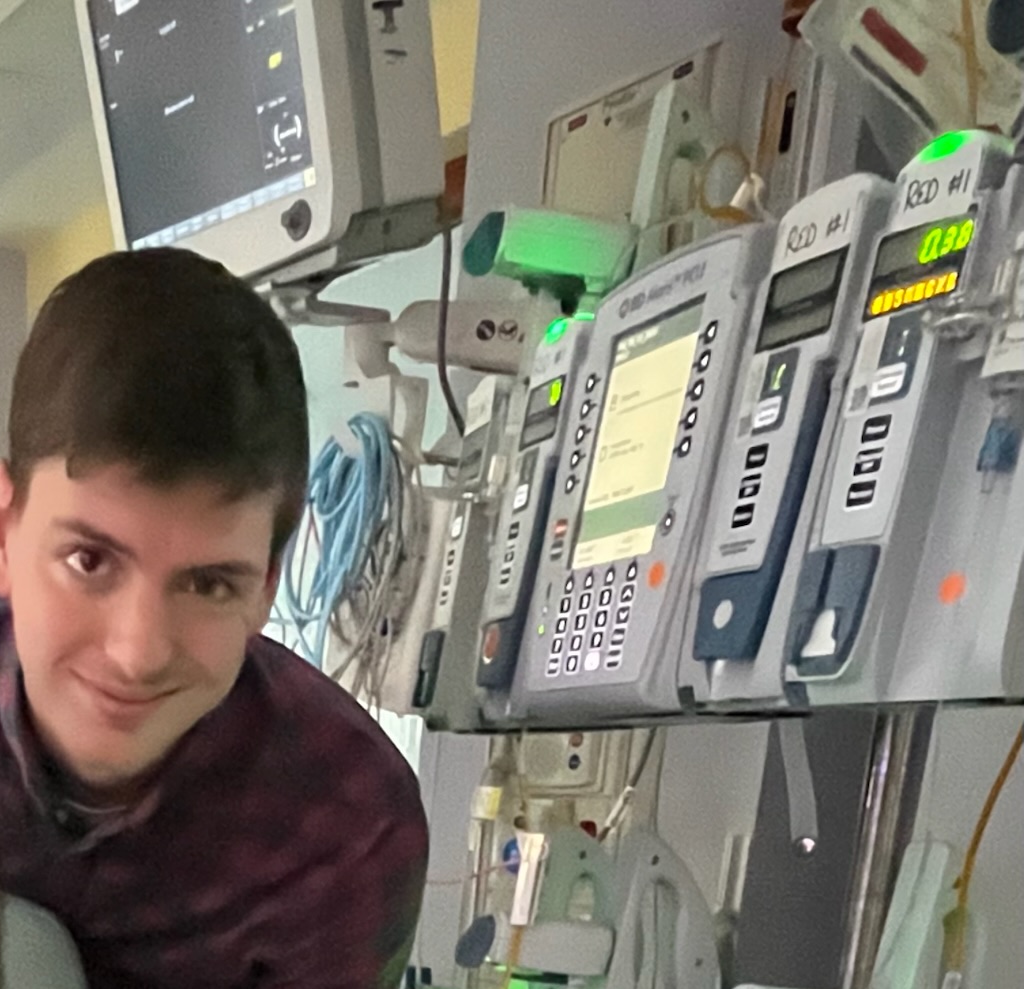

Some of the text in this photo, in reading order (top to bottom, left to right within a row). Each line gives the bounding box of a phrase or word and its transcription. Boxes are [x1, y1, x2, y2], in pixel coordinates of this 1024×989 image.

[904, 168, 972, 212] RED #1
[785, 208, 851, 257] RED #1
